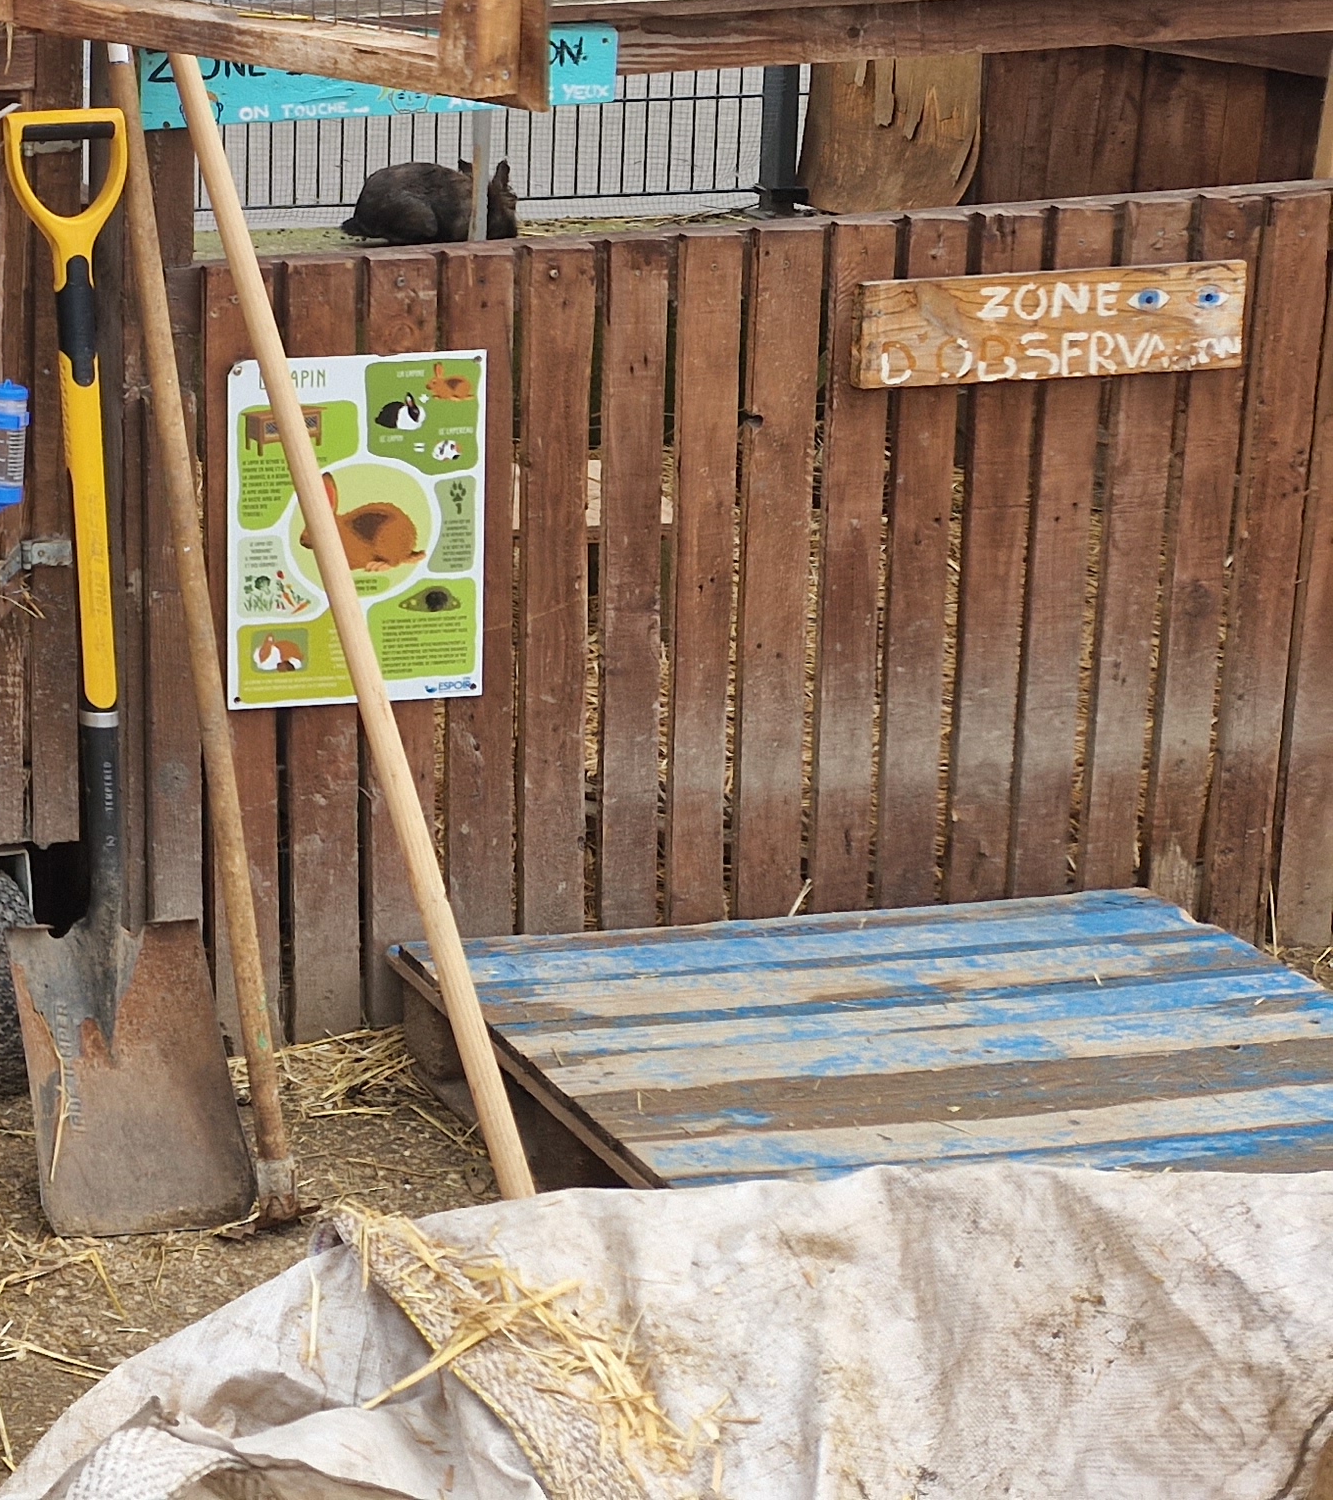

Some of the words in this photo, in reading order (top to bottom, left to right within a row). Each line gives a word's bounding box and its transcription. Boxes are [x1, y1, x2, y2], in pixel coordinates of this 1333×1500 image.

[561, 83, 611, 100] YEUX
[238, 103, 270, 121] ON
[976, 281, 1122, 321] ZONE
